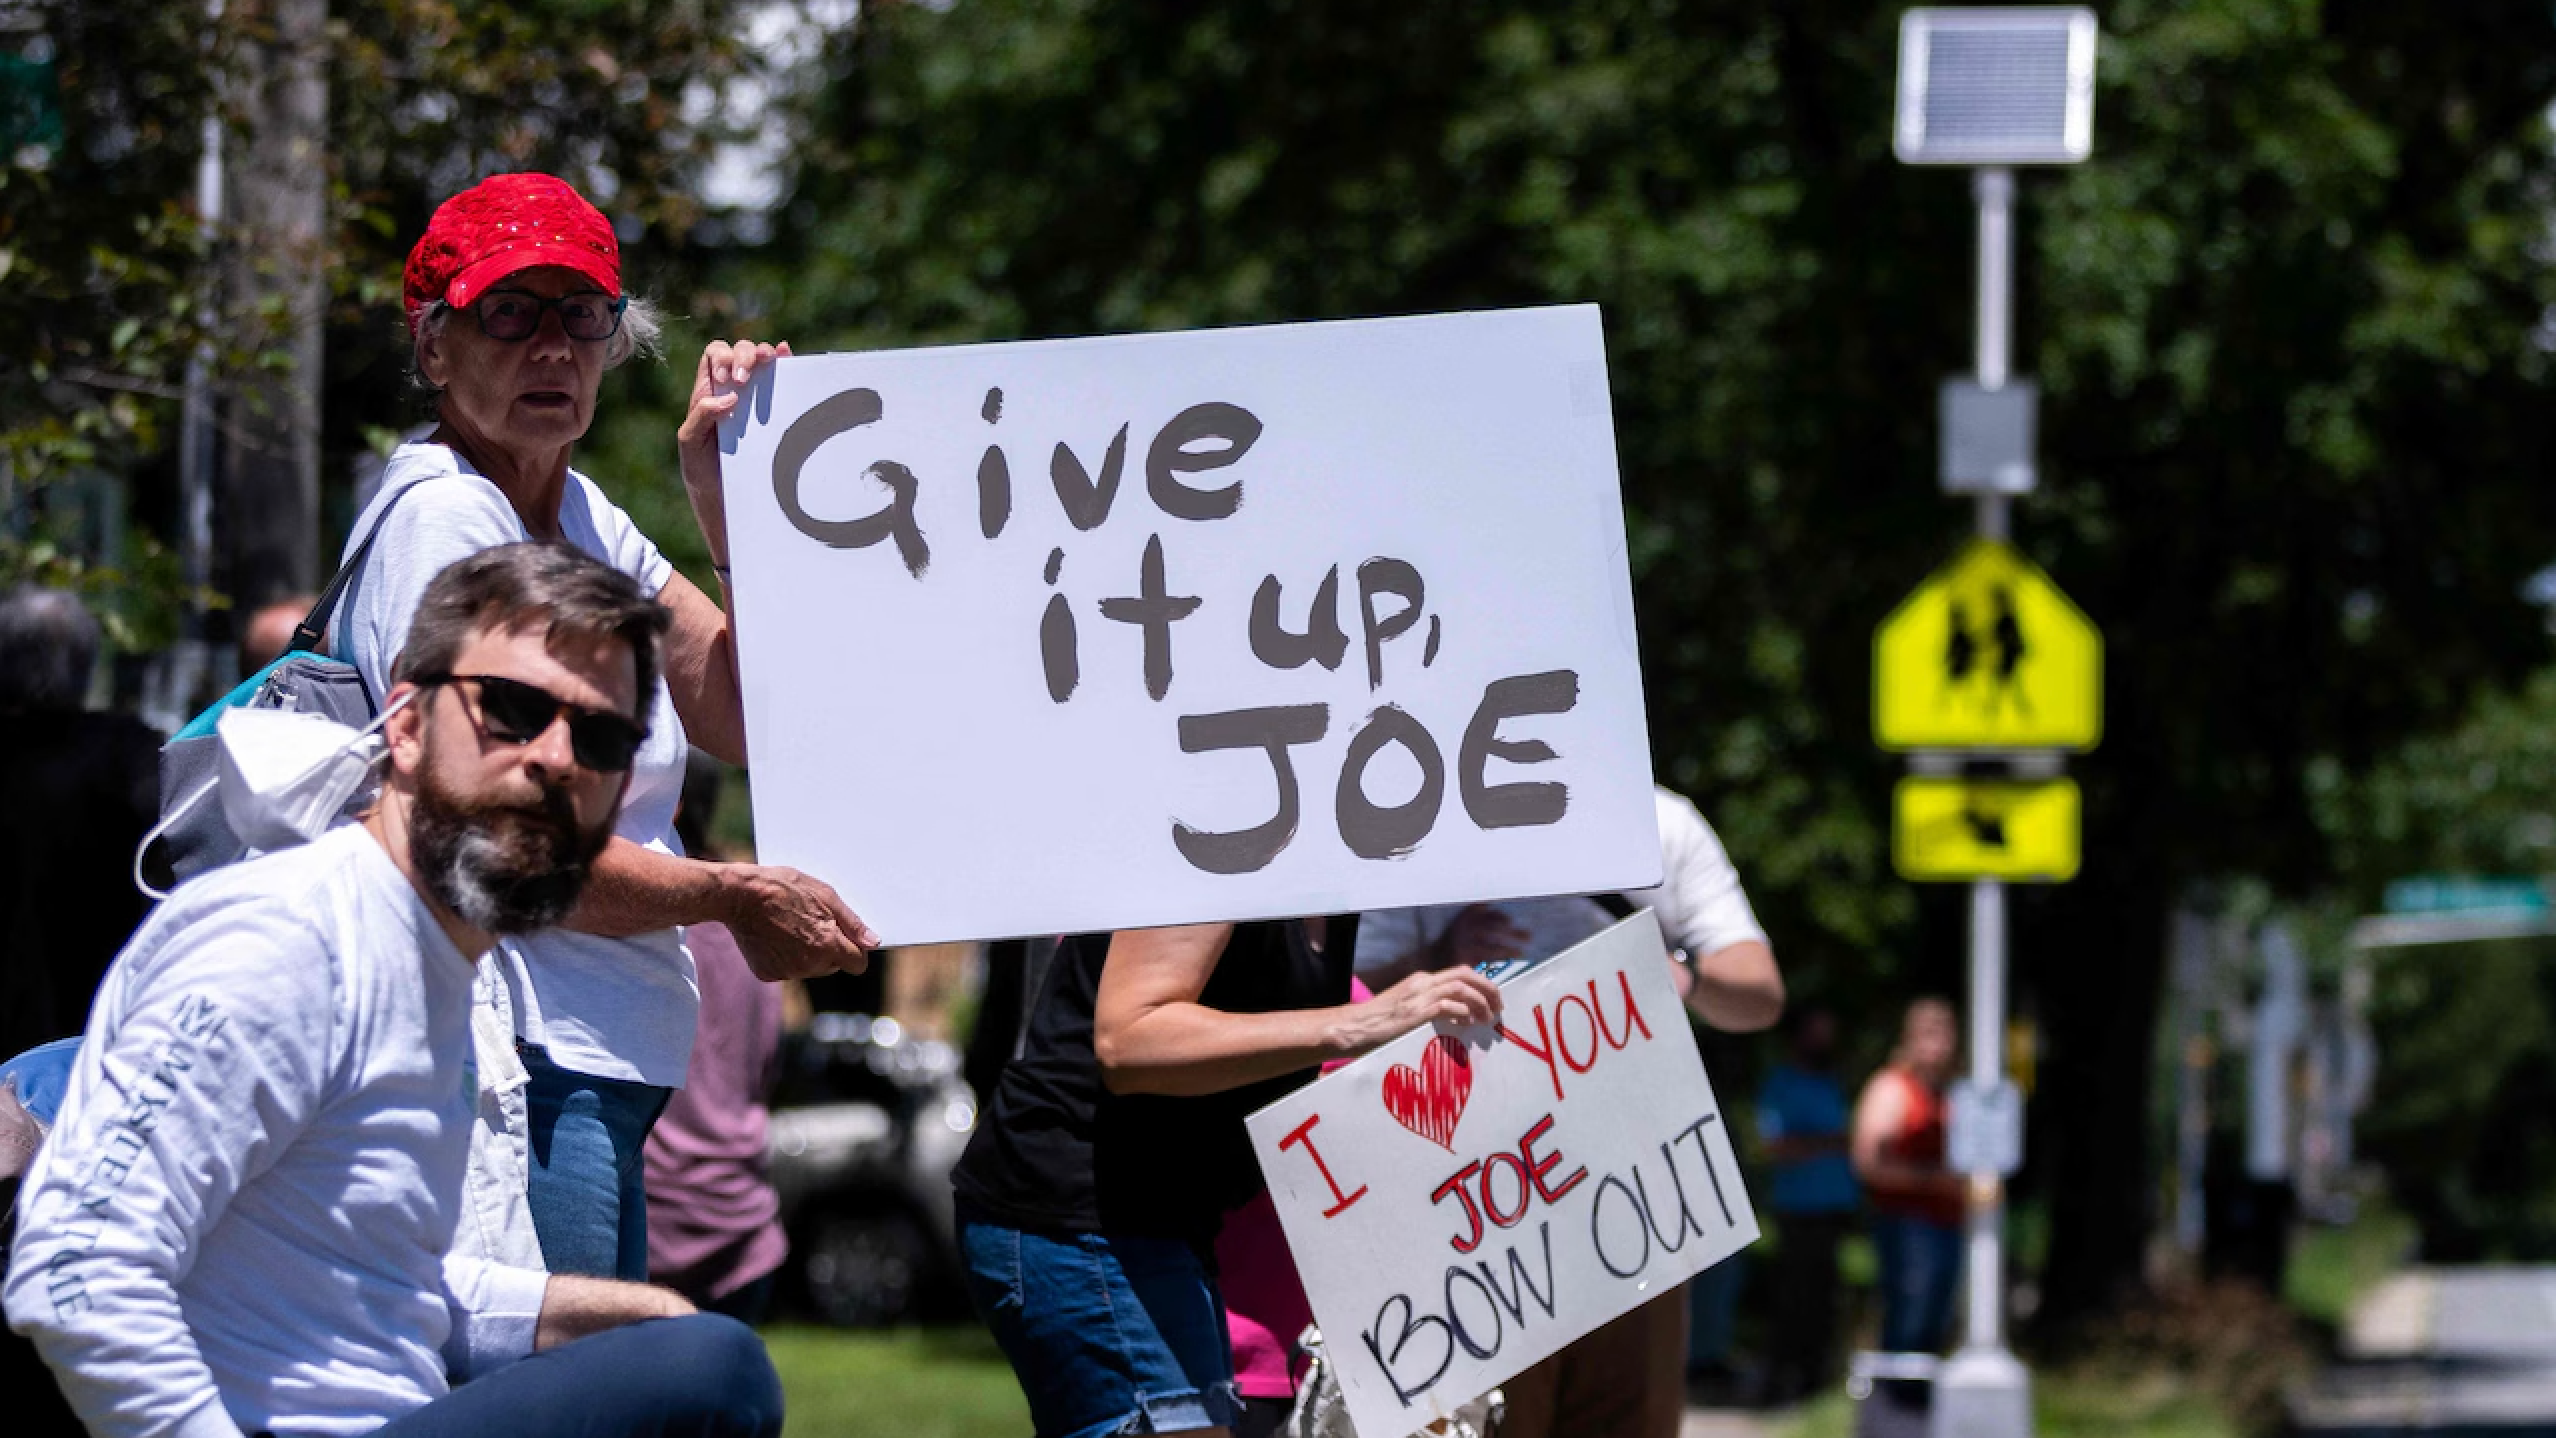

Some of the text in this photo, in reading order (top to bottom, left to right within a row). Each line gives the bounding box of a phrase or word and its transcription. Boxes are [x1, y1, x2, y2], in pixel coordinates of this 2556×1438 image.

[772, 386, 1264, 580] Give
[1039, 532, 1442, 704] it up,
[1171, 668, 1581, 875] JOE
[1278, 969, 1654, 1219] I YOU
[1431, 1113, 1589, 1255] JOE
[1361, 1113, 1737, 1408] BOW OUT
